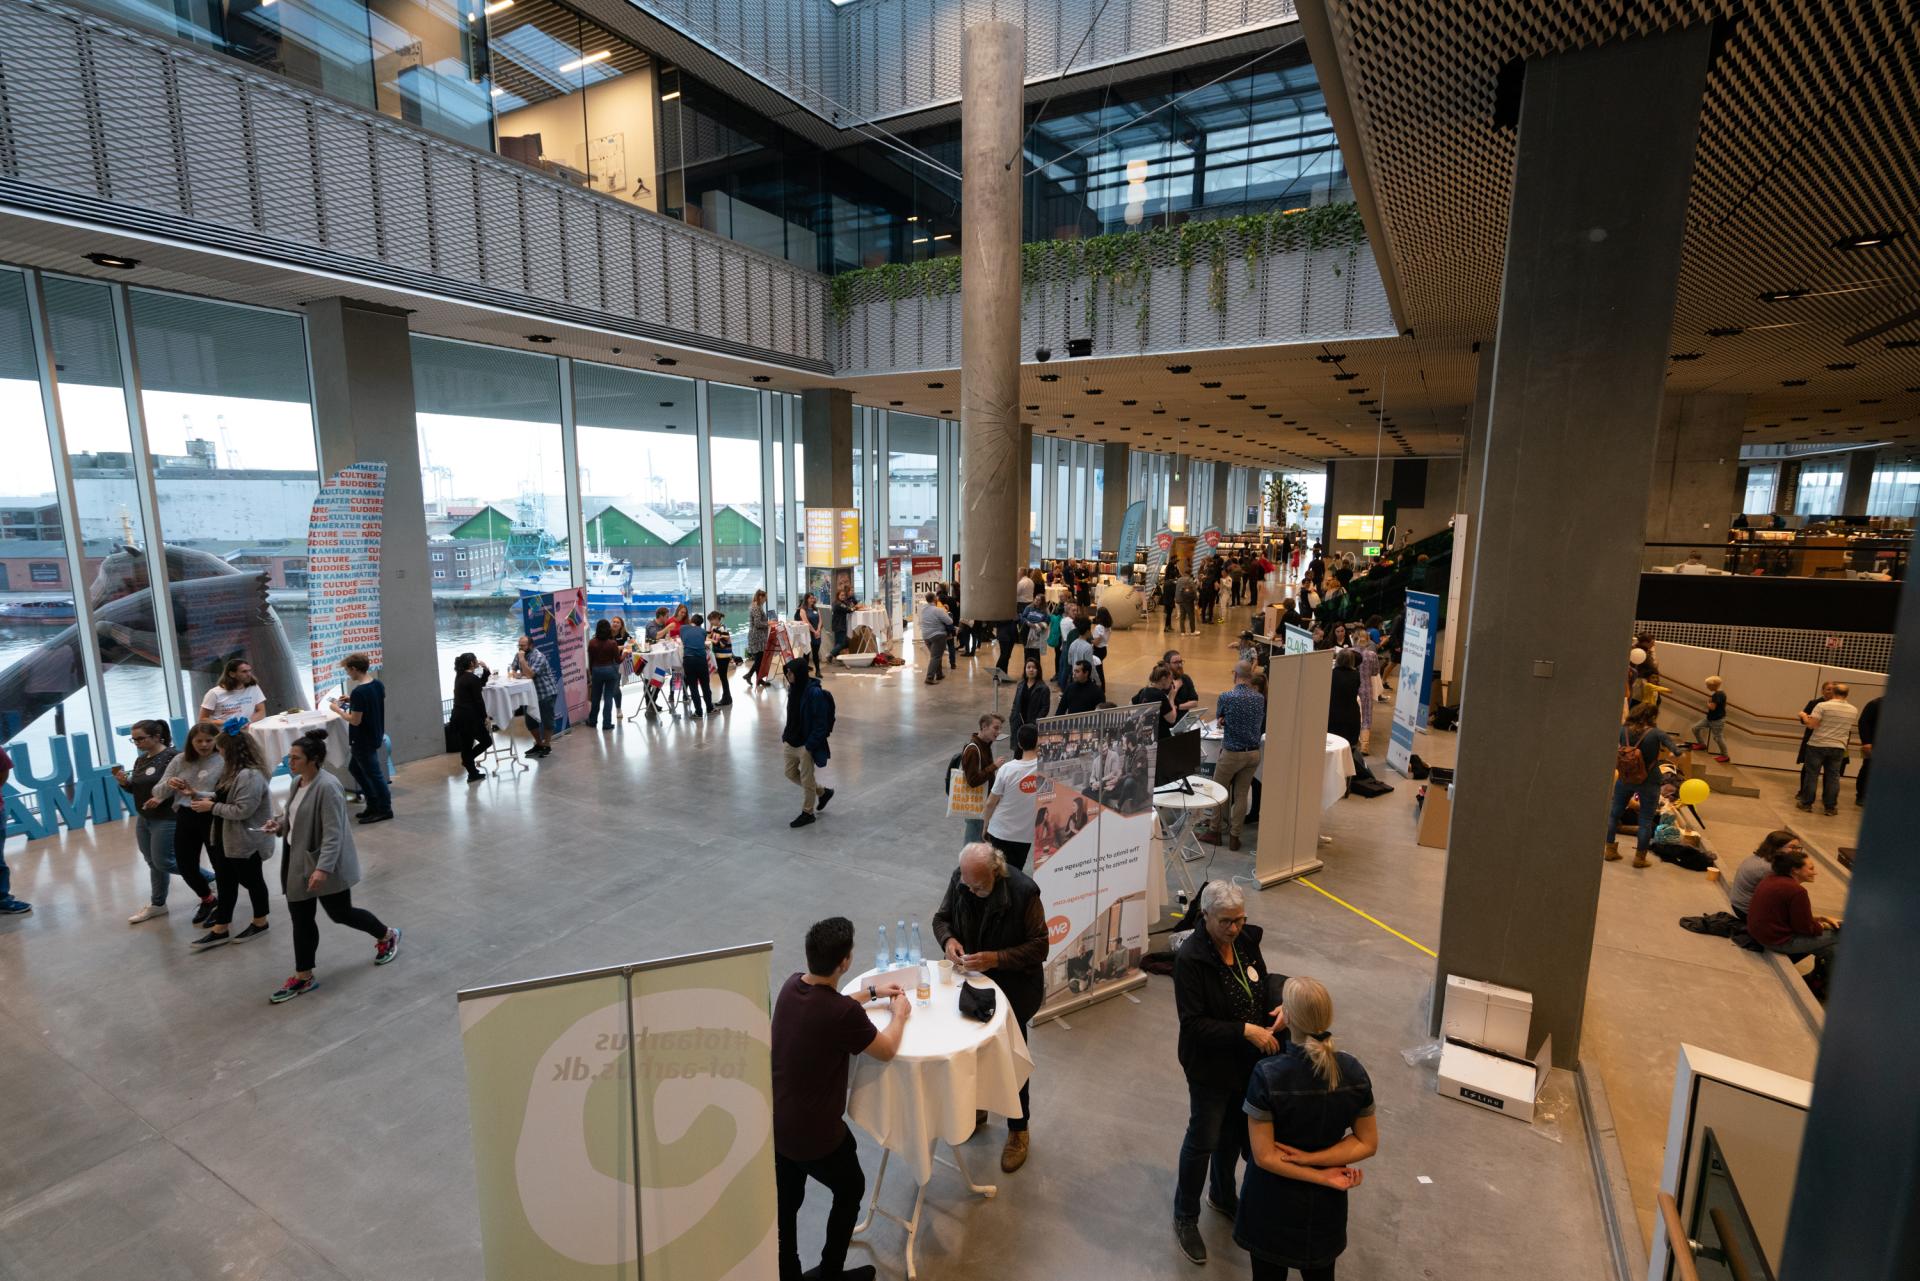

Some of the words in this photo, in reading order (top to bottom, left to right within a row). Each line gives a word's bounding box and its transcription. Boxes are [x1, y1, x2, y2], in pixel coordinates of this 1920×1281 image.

[339, 472, 379, 480] CULTURE
[311, 564, 351, 572] BUDDIES
[915, 581, 939, 593] FIND
[342, 626, 379, 636] CULTURE
[343, 634, 380, 644] BUDDIES
